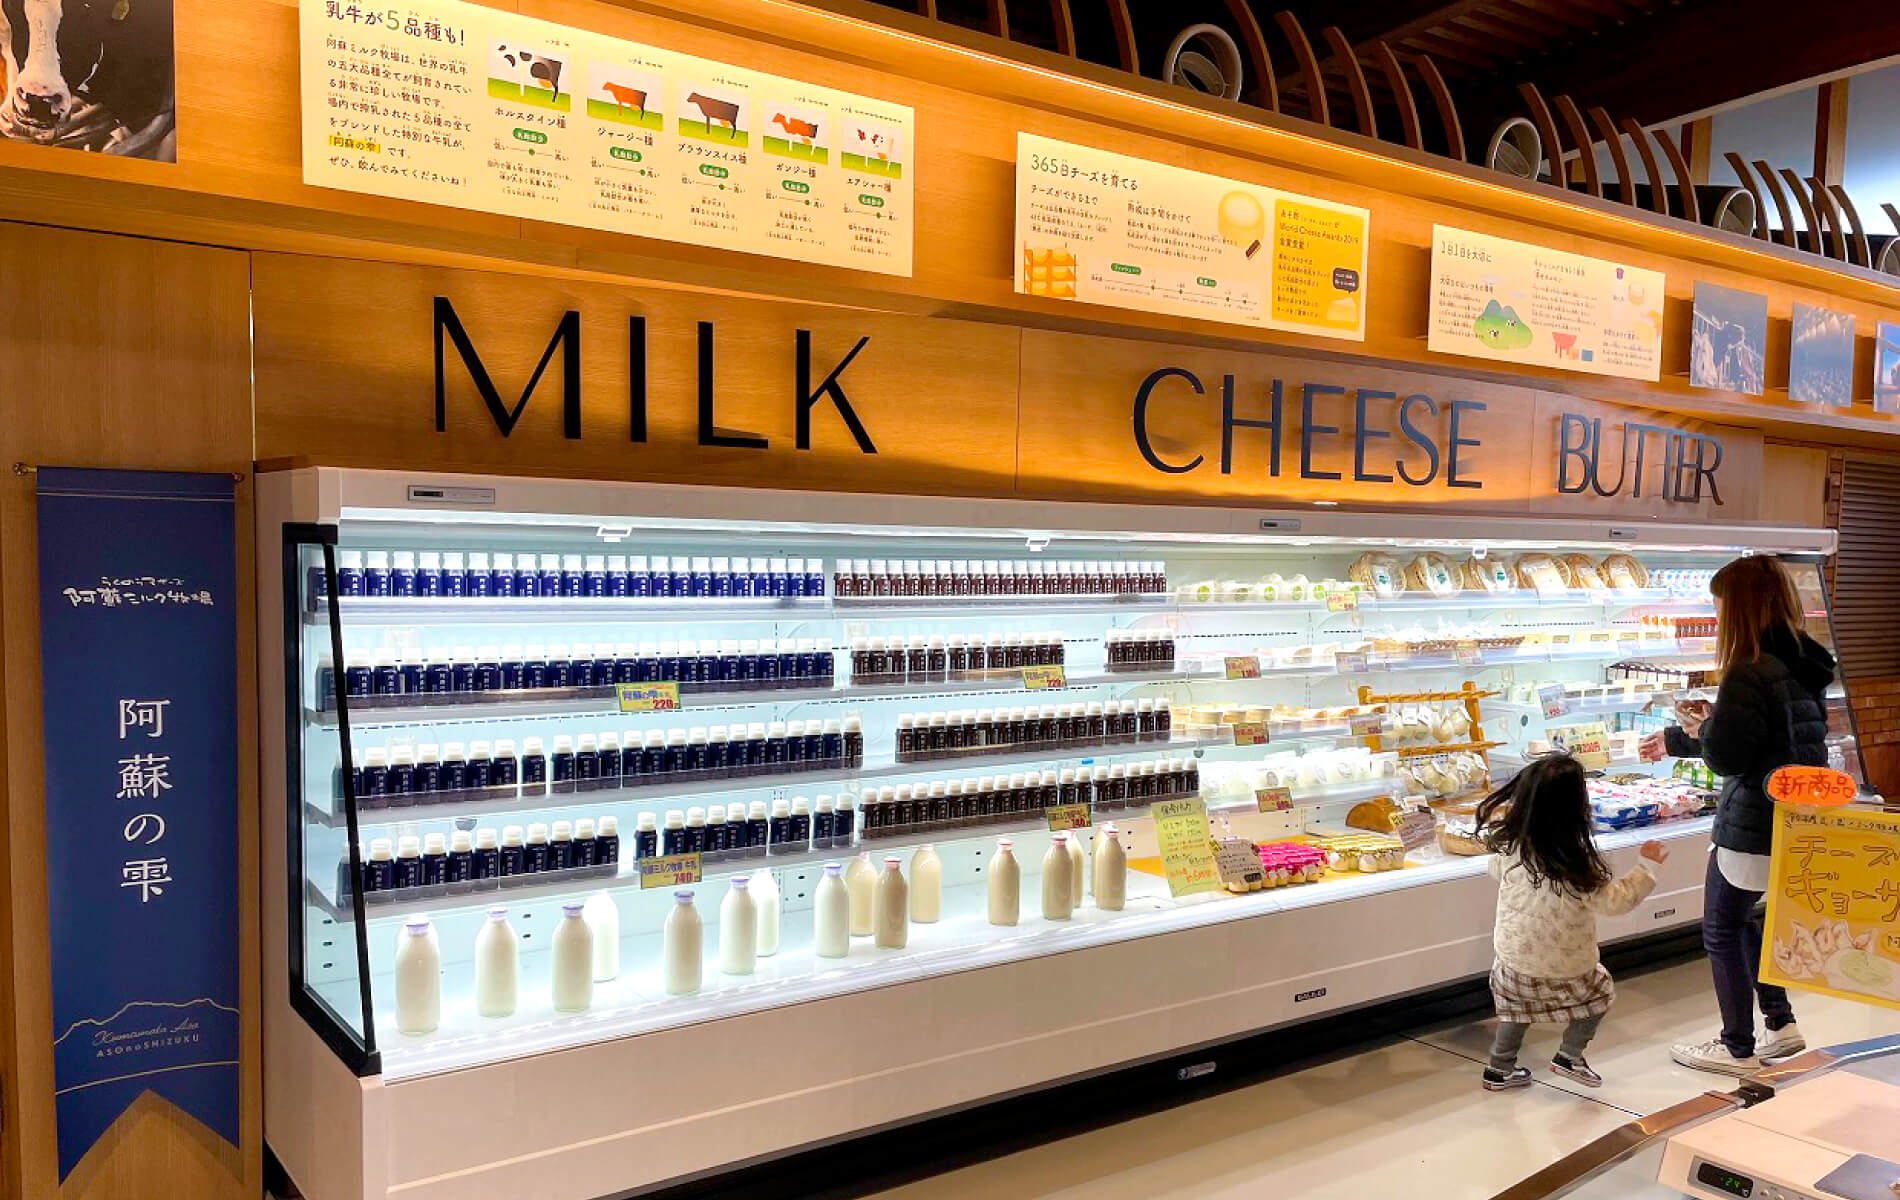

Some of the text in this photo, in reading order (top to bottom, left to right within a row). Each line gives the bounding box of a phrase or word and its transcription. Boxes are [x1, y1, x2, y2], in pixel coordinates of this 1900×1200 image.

[1031, 154, 1138, 191] 365日チーズを育てる
[433, 295, 879, 455] MILK
[1133, 366, 1488, 489] CHEESE
[1557, 411, 1725, 506] BUTTER
[117, 698, 173, 903] 阿蘇の雫
[1776, 770, 1855, 799] 新商品
